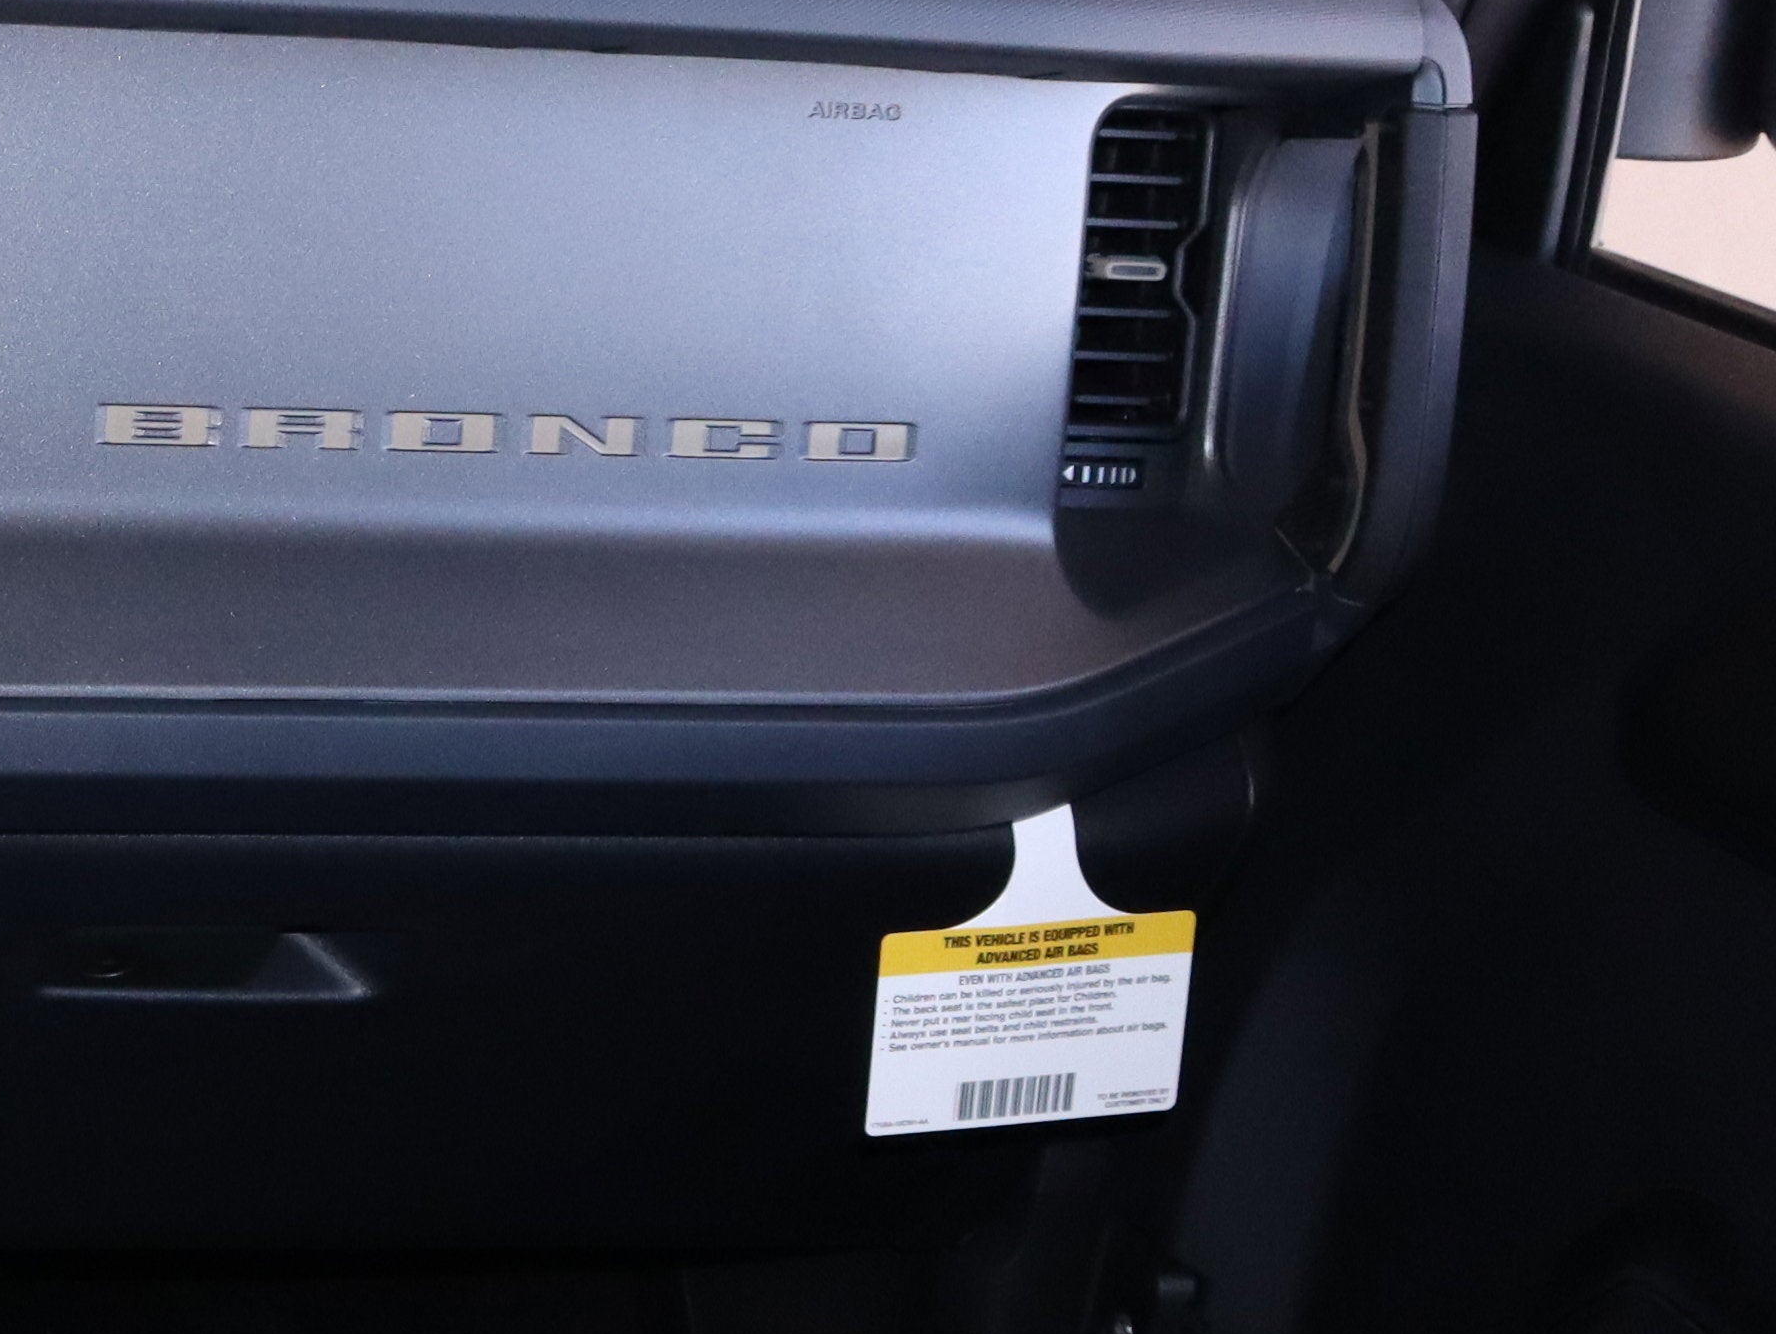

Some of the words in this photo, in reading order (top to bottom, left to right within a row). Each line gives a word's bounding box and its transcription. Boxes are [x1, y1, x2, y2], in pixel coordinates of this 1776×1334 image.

[809, 100, 903, 122] AIRBAG
[96, 402, 918, 463] BRONCO
[944, 935, 971, 948] THIS
[976, 932, 1025, 947] VEHICLE
[1029, 931, 1040, 943] IS
[1043, 926, 1101, 943] EQUIPPED
[1104, 922, 1135, 937] WITH
[976, 949, 1041, 965] ADVANCED
[1044, 946, 1064, 960] AIR
[1067, 943, 1099, 958] BAGS
[958, 973, 984, 986] EVEN
[987, 971, 1013, 985] WITH
[1015, 967, 1064, 983] ADVANCED
[1066, 965, 1084, 978] AIR
[1087, 963, 1111, 977] BAGS
[892, 992, 936, 1004] Children
[960, 989, 973, 1000] be
[975, 987, 1003, 999] killed
[1019, 983, 1064, 997] seriously
[1066, 979, 1101, 993] injured
[1104, 979, 1116, 990] by
[892, 1005, 910, 1016] The
[914, 1004, 937, 1015] back
[977, 1001, 992, 1011] the
[1028, 995, 1055, 1009] place
[1058, 994, 1072, 1004] for
[889, 1029, 927, 1042] Always
[975, 1023, 1000, 1035] belts
[1002, 1021, 1021, 1033] and
[1023, 1018, 1047, 1031] child
[890, 1017, 918, 1029] Never
[922, 1016, 941, 1028] put
[975, 1011, 1006, 1025] facing
[1008, 1008, 1033, 1021] child
[888, 1042, 908, 1053] See
[910, 1038, 951, 1051] owner's
[953, 1035, 991, 1048] manual
[1010, 1032, 1035, 1043] more
[1037, 1027, 1095, 1042] information
[1096, 1023, 1125, 1036] about
